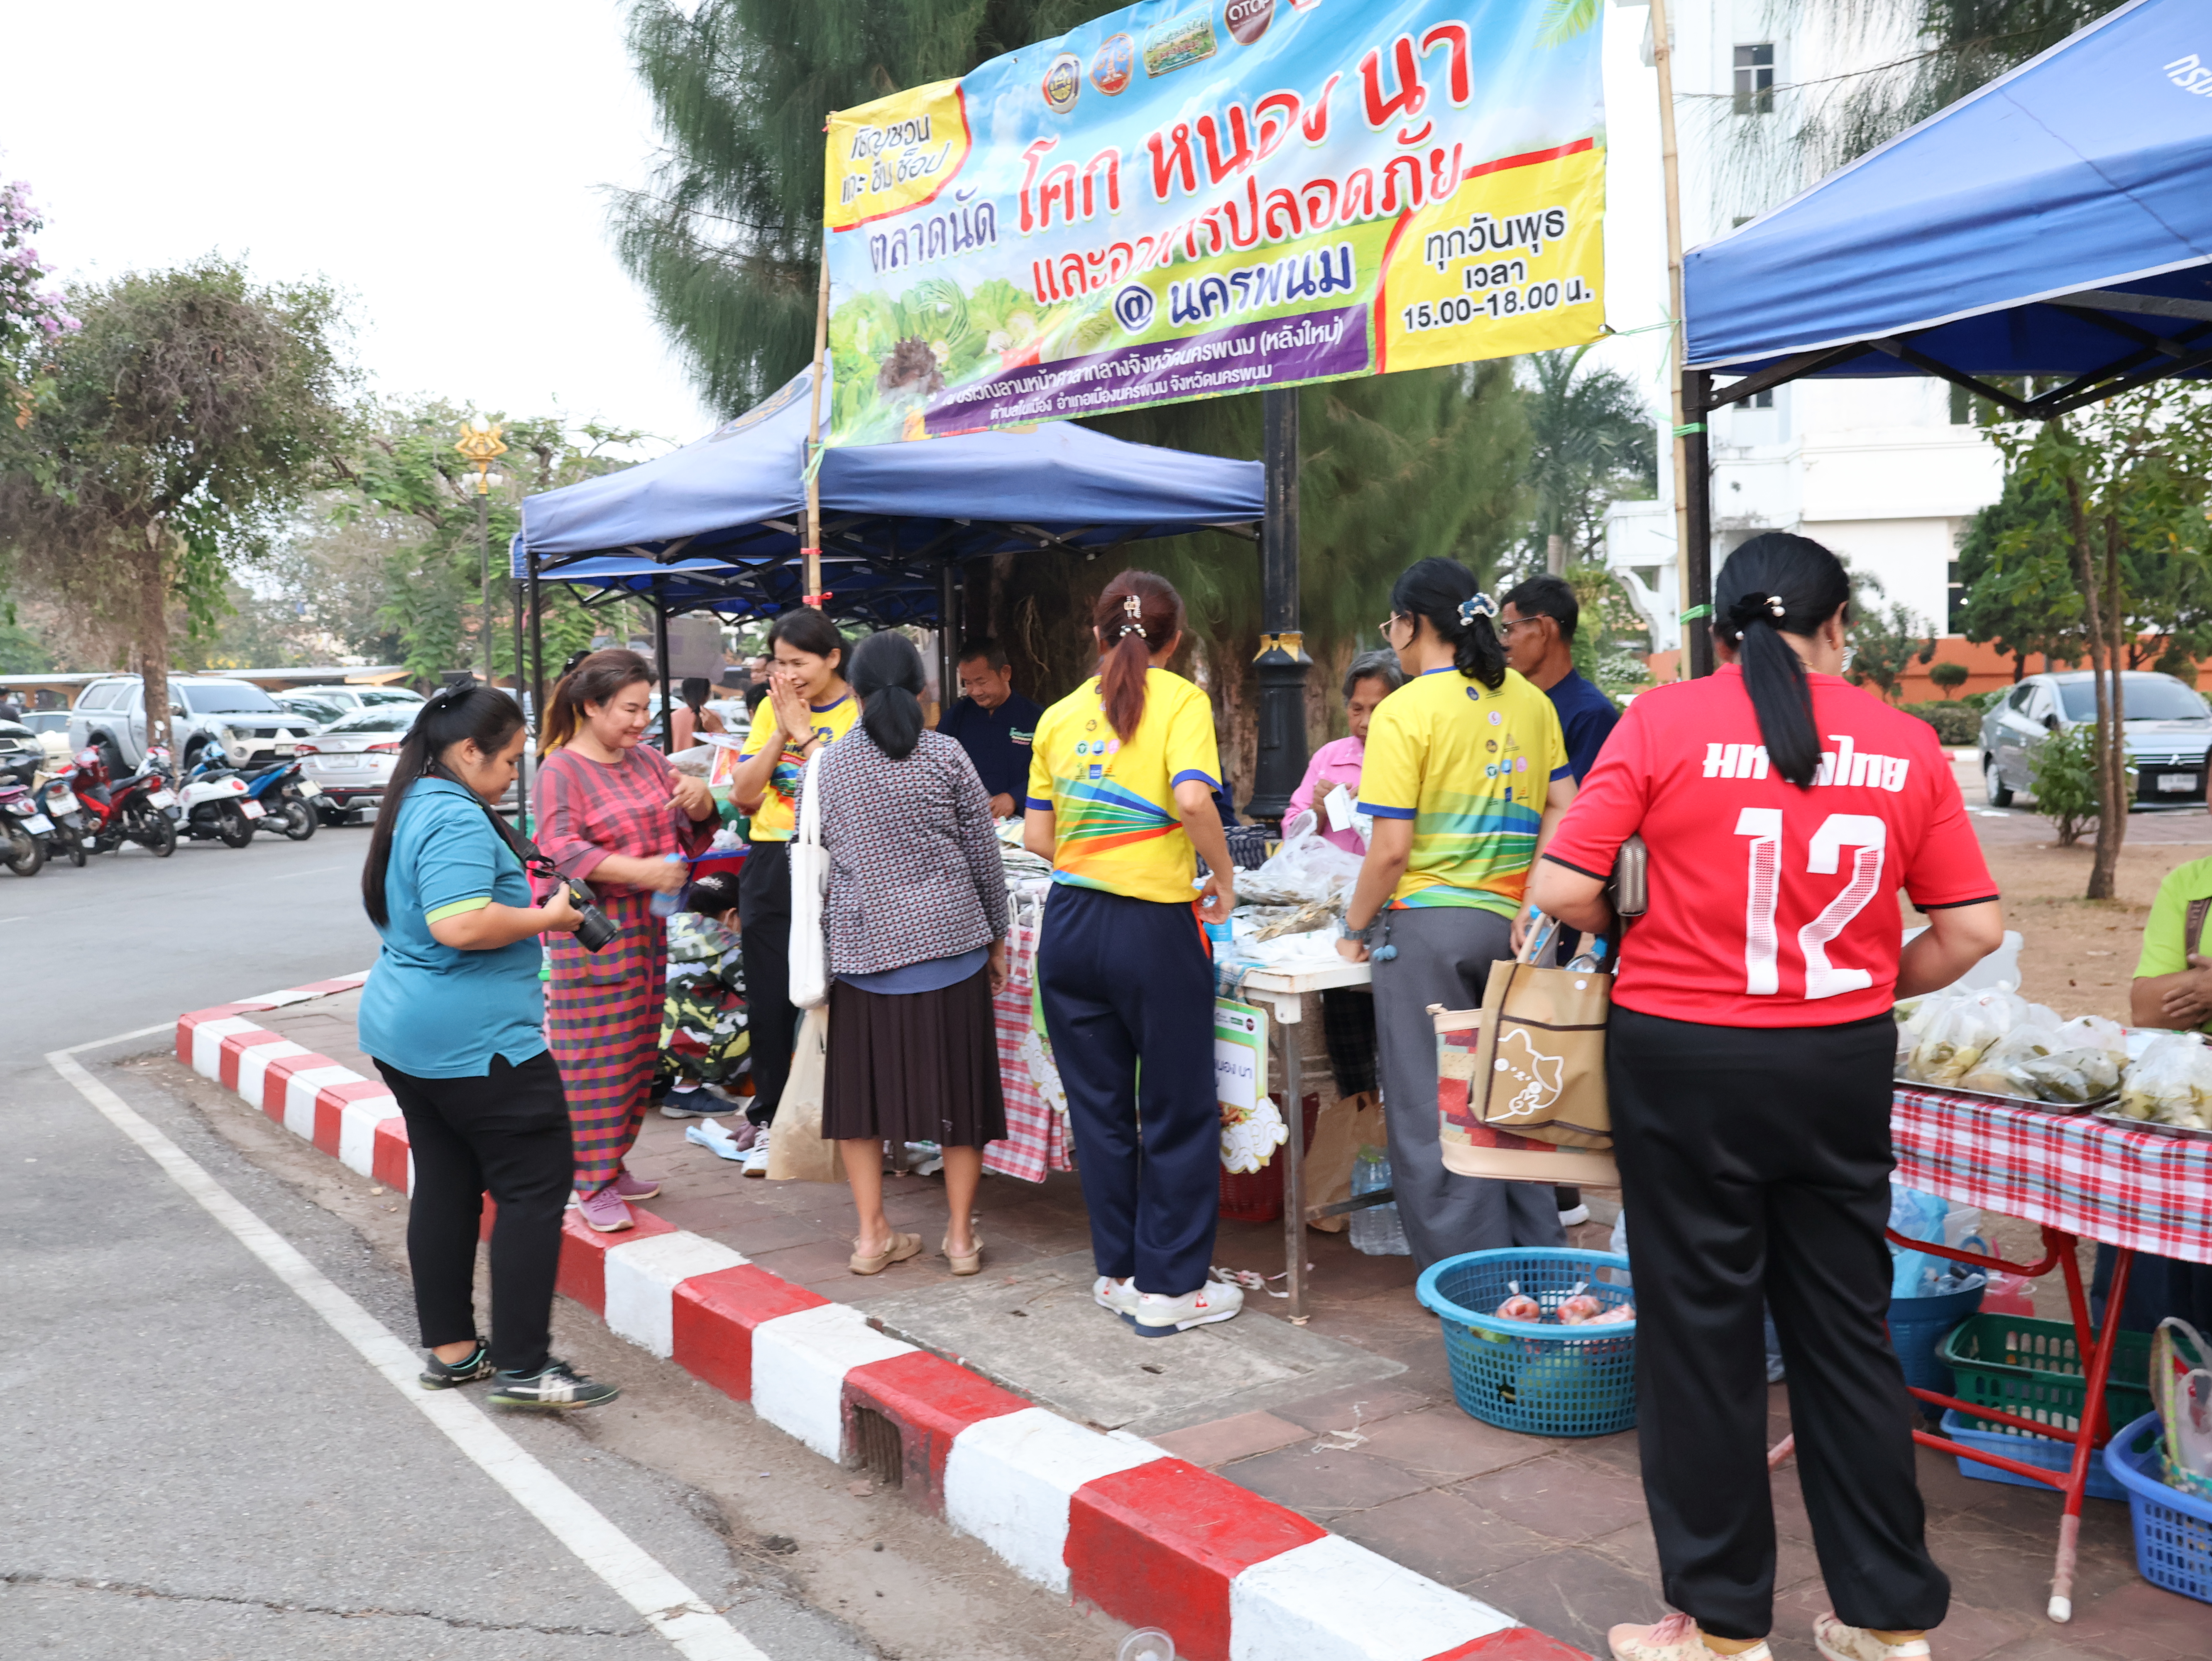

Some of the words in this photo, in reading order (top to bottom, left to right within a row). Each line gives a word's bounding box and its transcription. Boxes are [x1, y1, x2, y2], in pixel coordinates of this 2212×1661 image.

[1228, 0, 1270, 21] OTOP
[851, 115, 930, 159] เชิญชวน
[871, 185, 996, 274] ตลาดนัด
[1019, 134, 1120, 233] โคก
[1147, 74, 1341, 199] หนอง
[1360, 24, 1470, 126] นา
[1033, 120, 1463, 302] และอาหารปลอดภัย
[1427, 210, 1564, 270] ทุกวันพุธ
[1116, 286, 1154, 331] @
[1171, 246, 1352, 323] นครพนม
[1466, 260, 1523, 289] เวลา
[1403, 282, 1558, 329] 15.00-18.00
[1566, 279, 1591, 301] น.
[1260, 316, 1344, 356] (หลังใหม่)
[1170, 364, 1272, 392] จังหวัดนครพนม
[1702, 735, 1910, 793] มหดไทย
[1734, 807, 1887, 1000] 12
